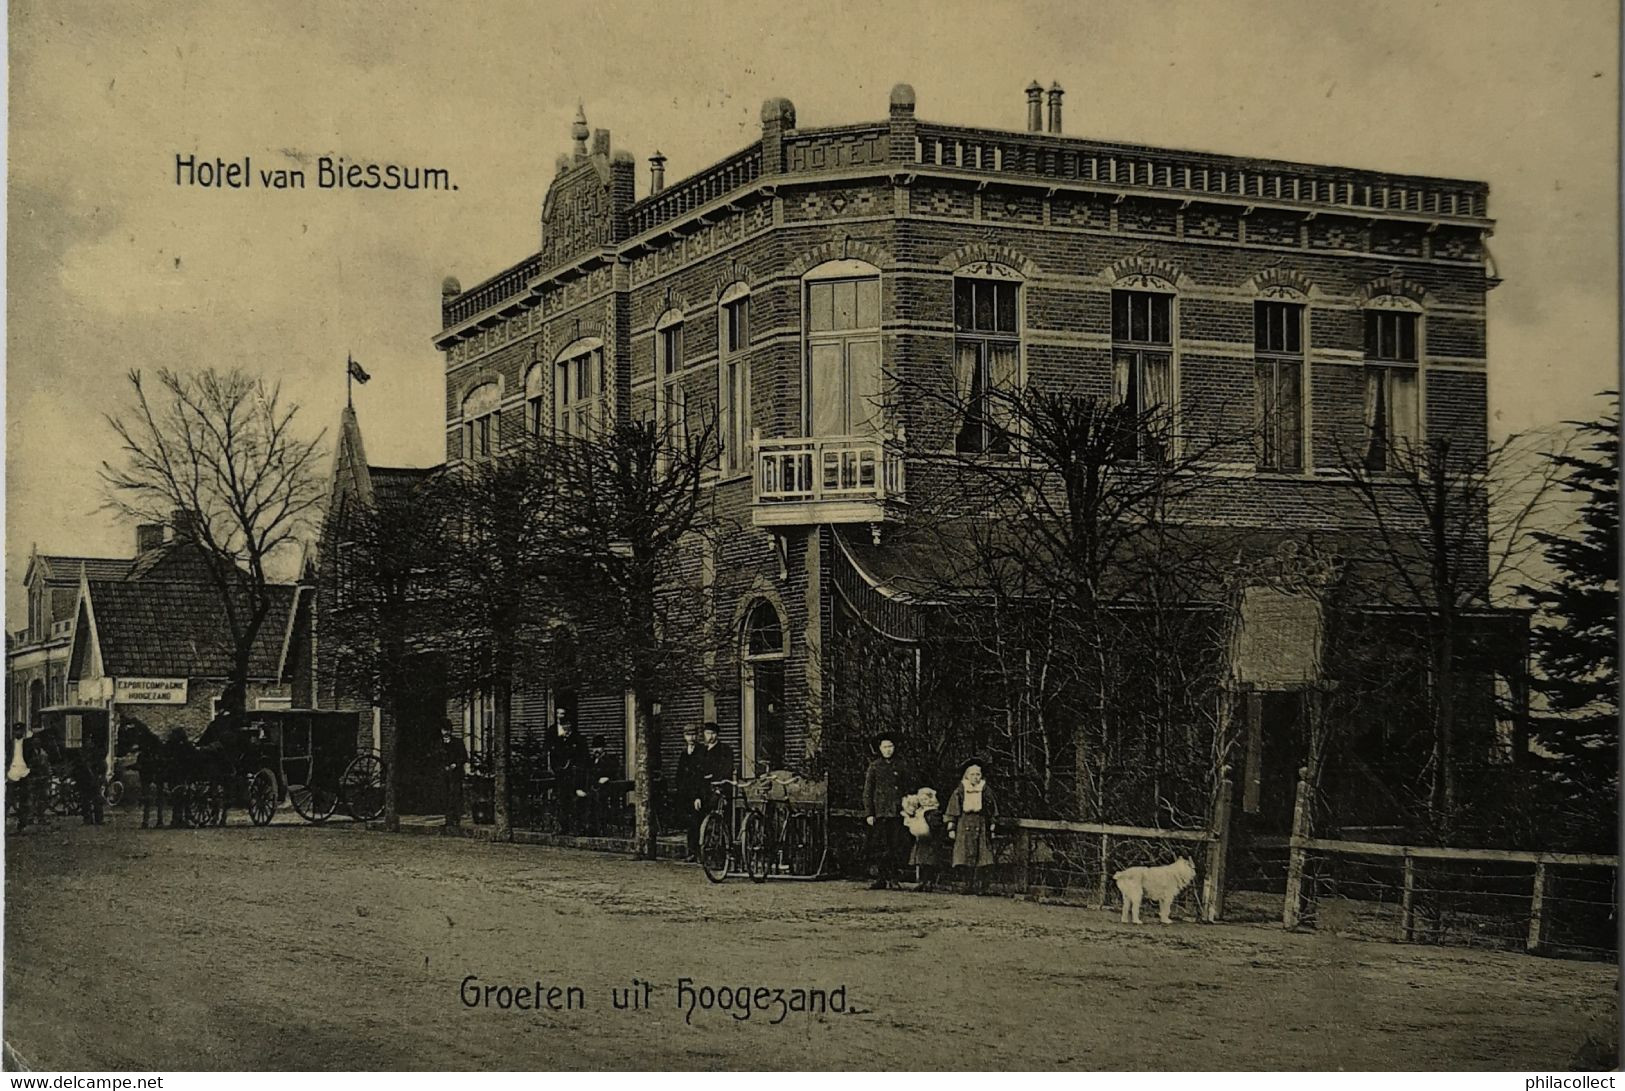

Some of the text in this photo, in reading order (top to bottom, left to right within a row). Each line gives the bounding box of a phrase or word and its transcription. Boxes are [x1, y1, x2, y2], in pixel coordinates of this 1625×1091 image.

[793, 139, 883, 171] HOTEL
[118, 681, 185, 690] EXPORTCOMPAGNIE
[128, 692, 171, 700] HOOGEZAND
